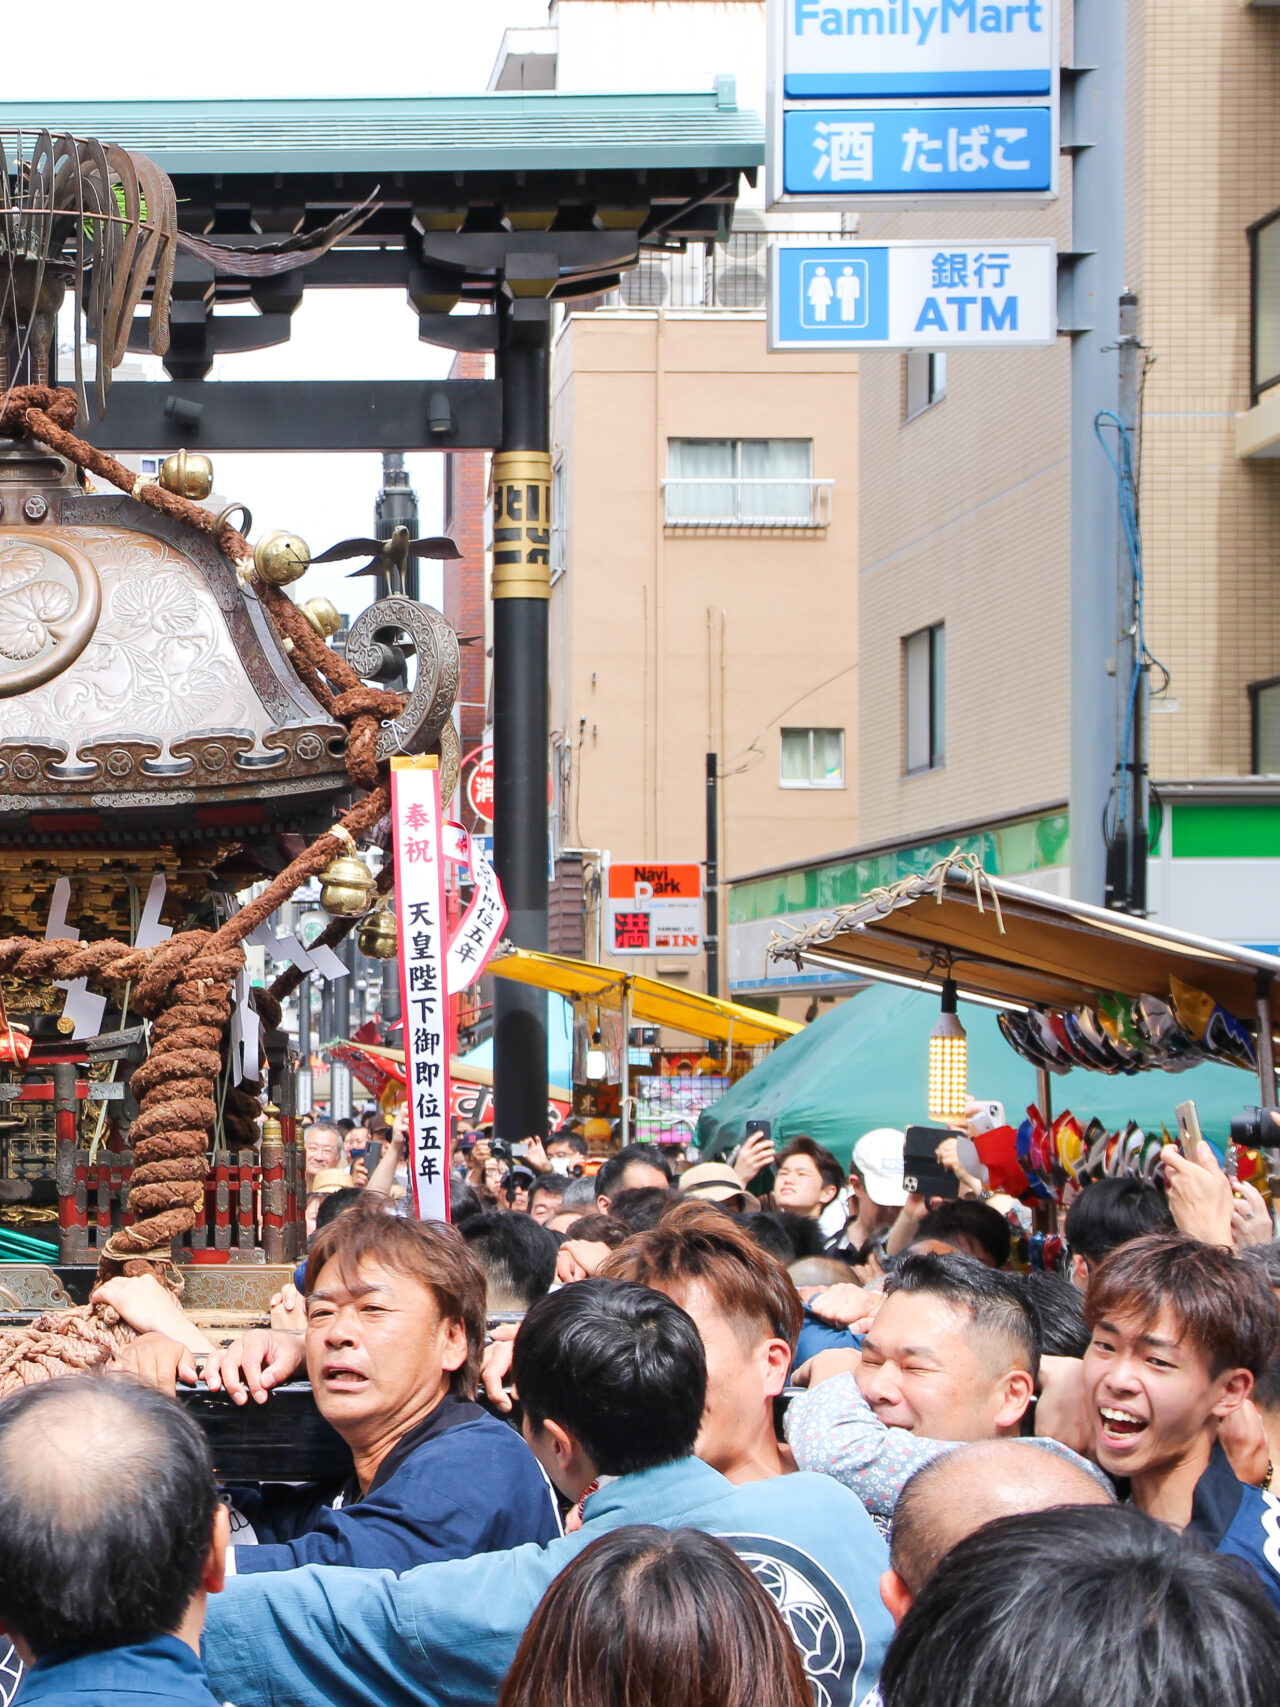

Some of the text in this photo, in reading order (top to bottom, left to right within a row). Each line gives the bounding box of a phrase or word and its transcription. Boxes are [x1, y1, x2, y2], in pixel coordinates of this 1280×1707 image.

[794, 0, 1042, 45] FamilyMart
[812, 121, 1031, 182] 酒 たばこ
[931, 252, 1011, 289] 銀行
[913, 296, 1019, 332] ATM
[634, 866, 668, 882] Navi
[634, 878, 680, 910] Park
[615, 913, 650, 949] 満
[672, 935, 699, 947] IN
[403, 802, 442, 1185] 奉祝 天皇陛下御即位五年
